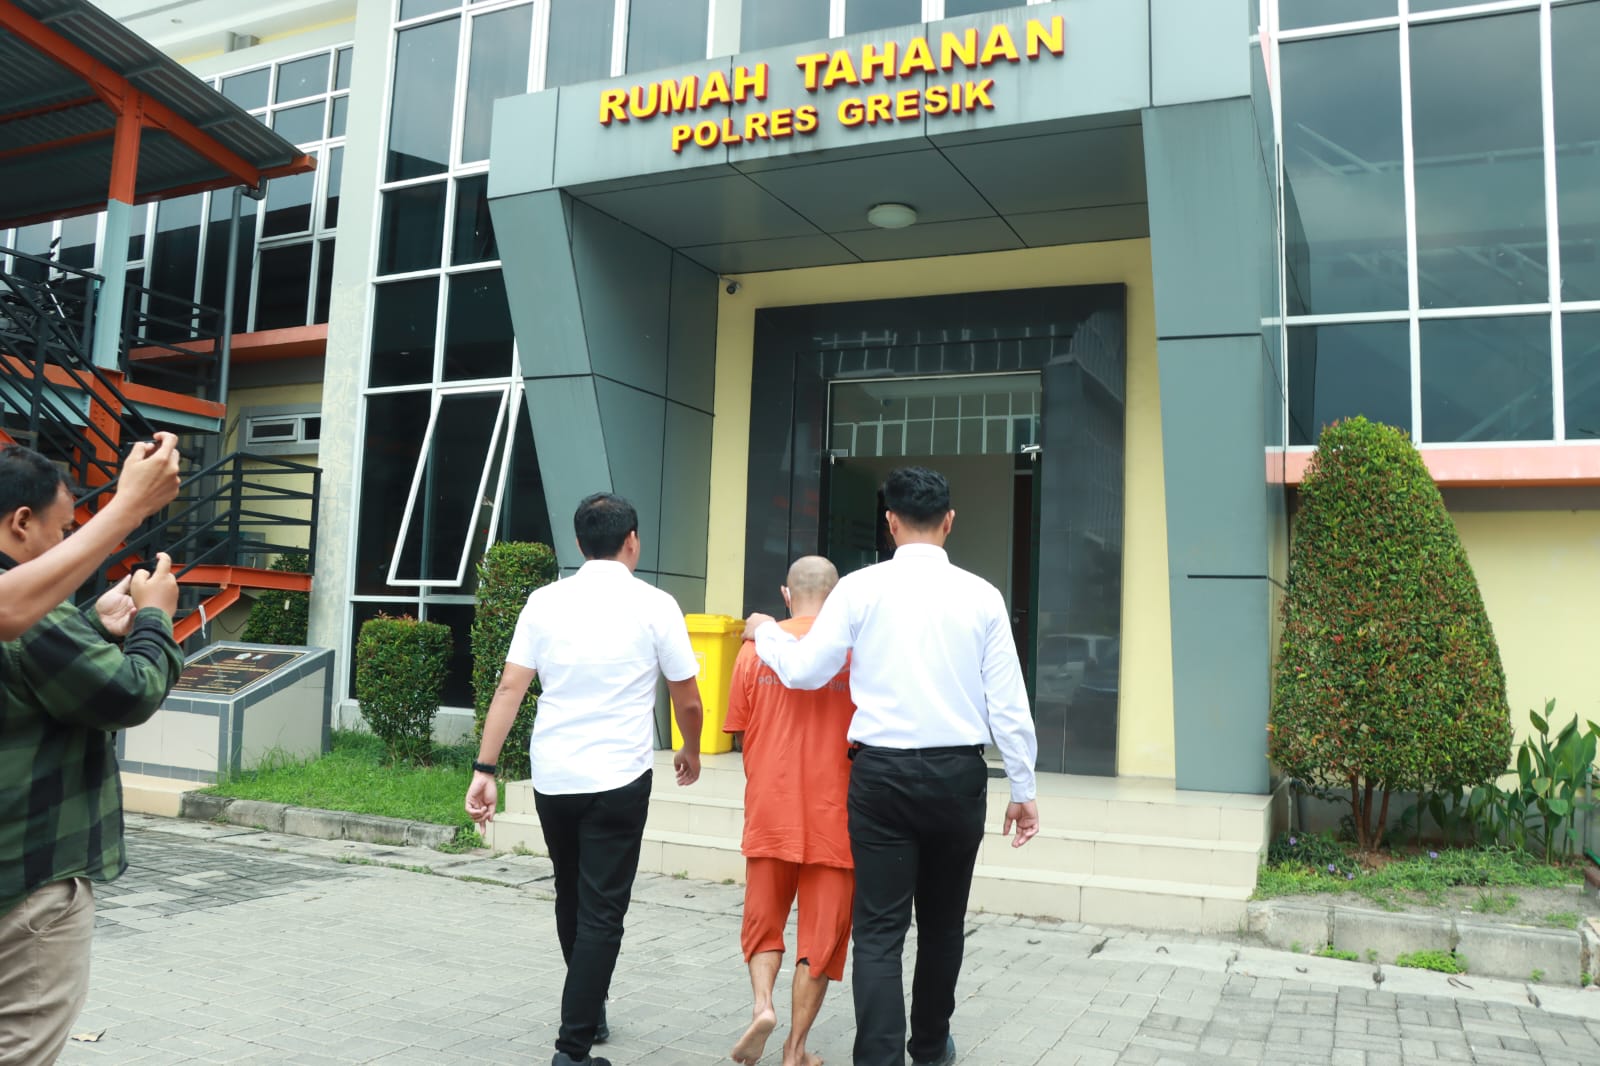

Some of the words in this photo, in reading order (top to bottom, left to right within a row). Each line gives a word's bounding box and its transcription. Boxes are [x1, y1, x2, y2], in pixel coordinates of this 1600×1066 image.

[599, 63, 769, 125] RUMAH
[796, 16, 1064, 91] TAHANAN
[671, 105, 818, 152] POLRES
[837, 79, 994, 127] GRESIK
